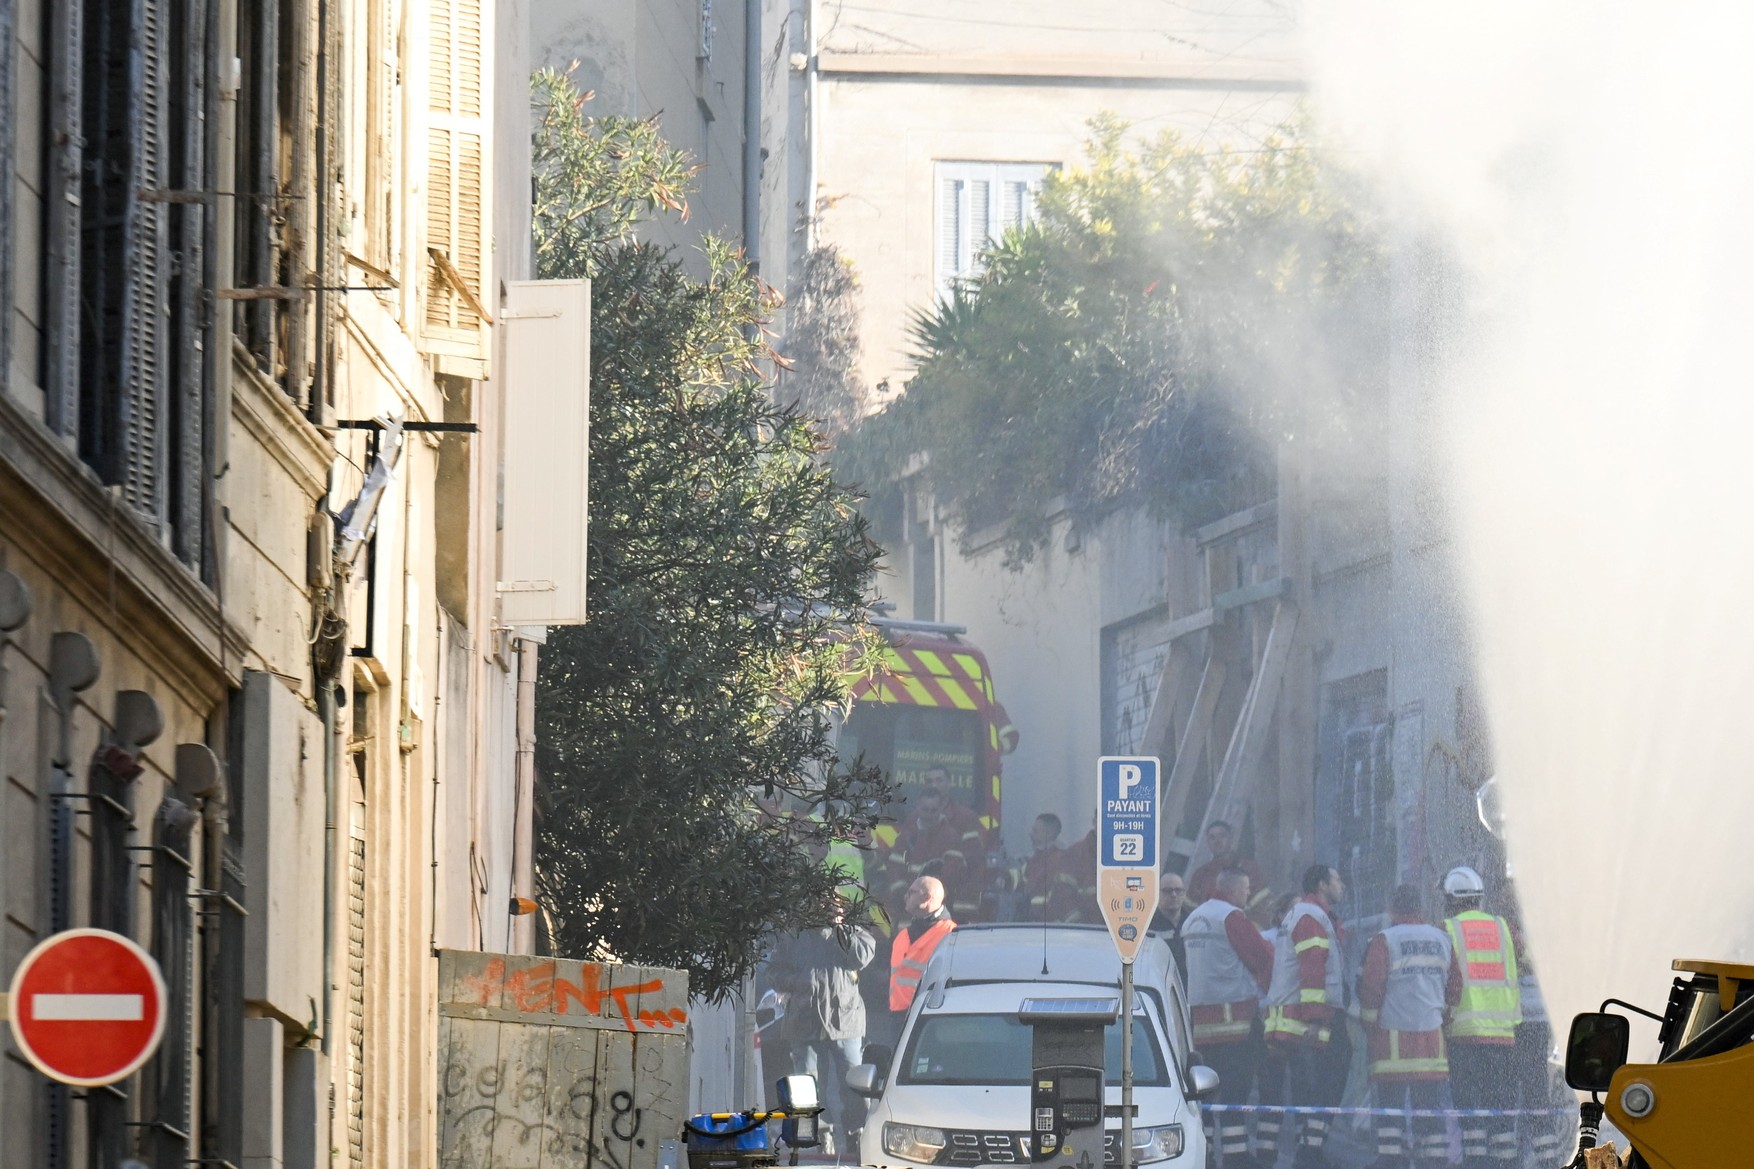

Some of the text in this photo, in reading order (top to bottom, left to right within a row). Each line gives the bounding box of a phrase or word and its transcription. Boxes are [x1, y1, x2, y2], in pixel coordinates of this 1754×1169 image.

[895, 770, 973, 788] MARLLE
[1119, 764, 1142, 799] P
[1107, 800, 1152, 812] PAYANT
[1113, 821, 1144, 830] 9H-19H
[1120, 843, 1137, 856] 22
